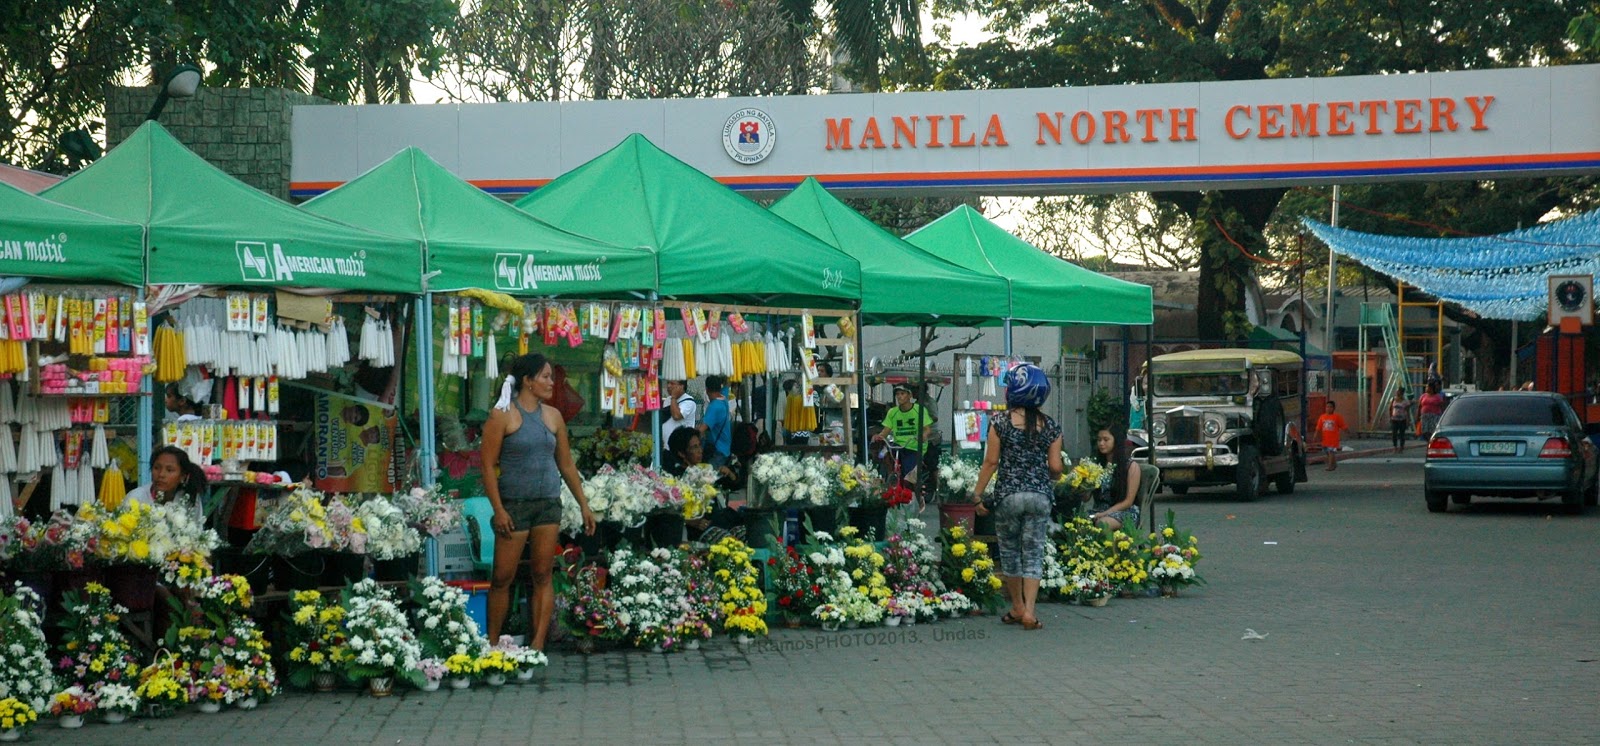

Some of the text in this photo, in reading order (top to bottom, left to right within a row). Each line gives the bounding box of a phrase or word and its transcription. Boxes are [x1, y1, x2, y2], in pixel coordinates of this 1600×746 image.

[724, 110, 745, 137] LUNGSOD
[757, 112, 775, 137] MAYNILA
[826, 96, 1496, 150] MANILA NORTH CEMETERY
[734, 153, 764, 162] PILIPINAS
[272, 243, 337, 281] AMERICAN
[522, 254, 575, 289] AMERICAN
